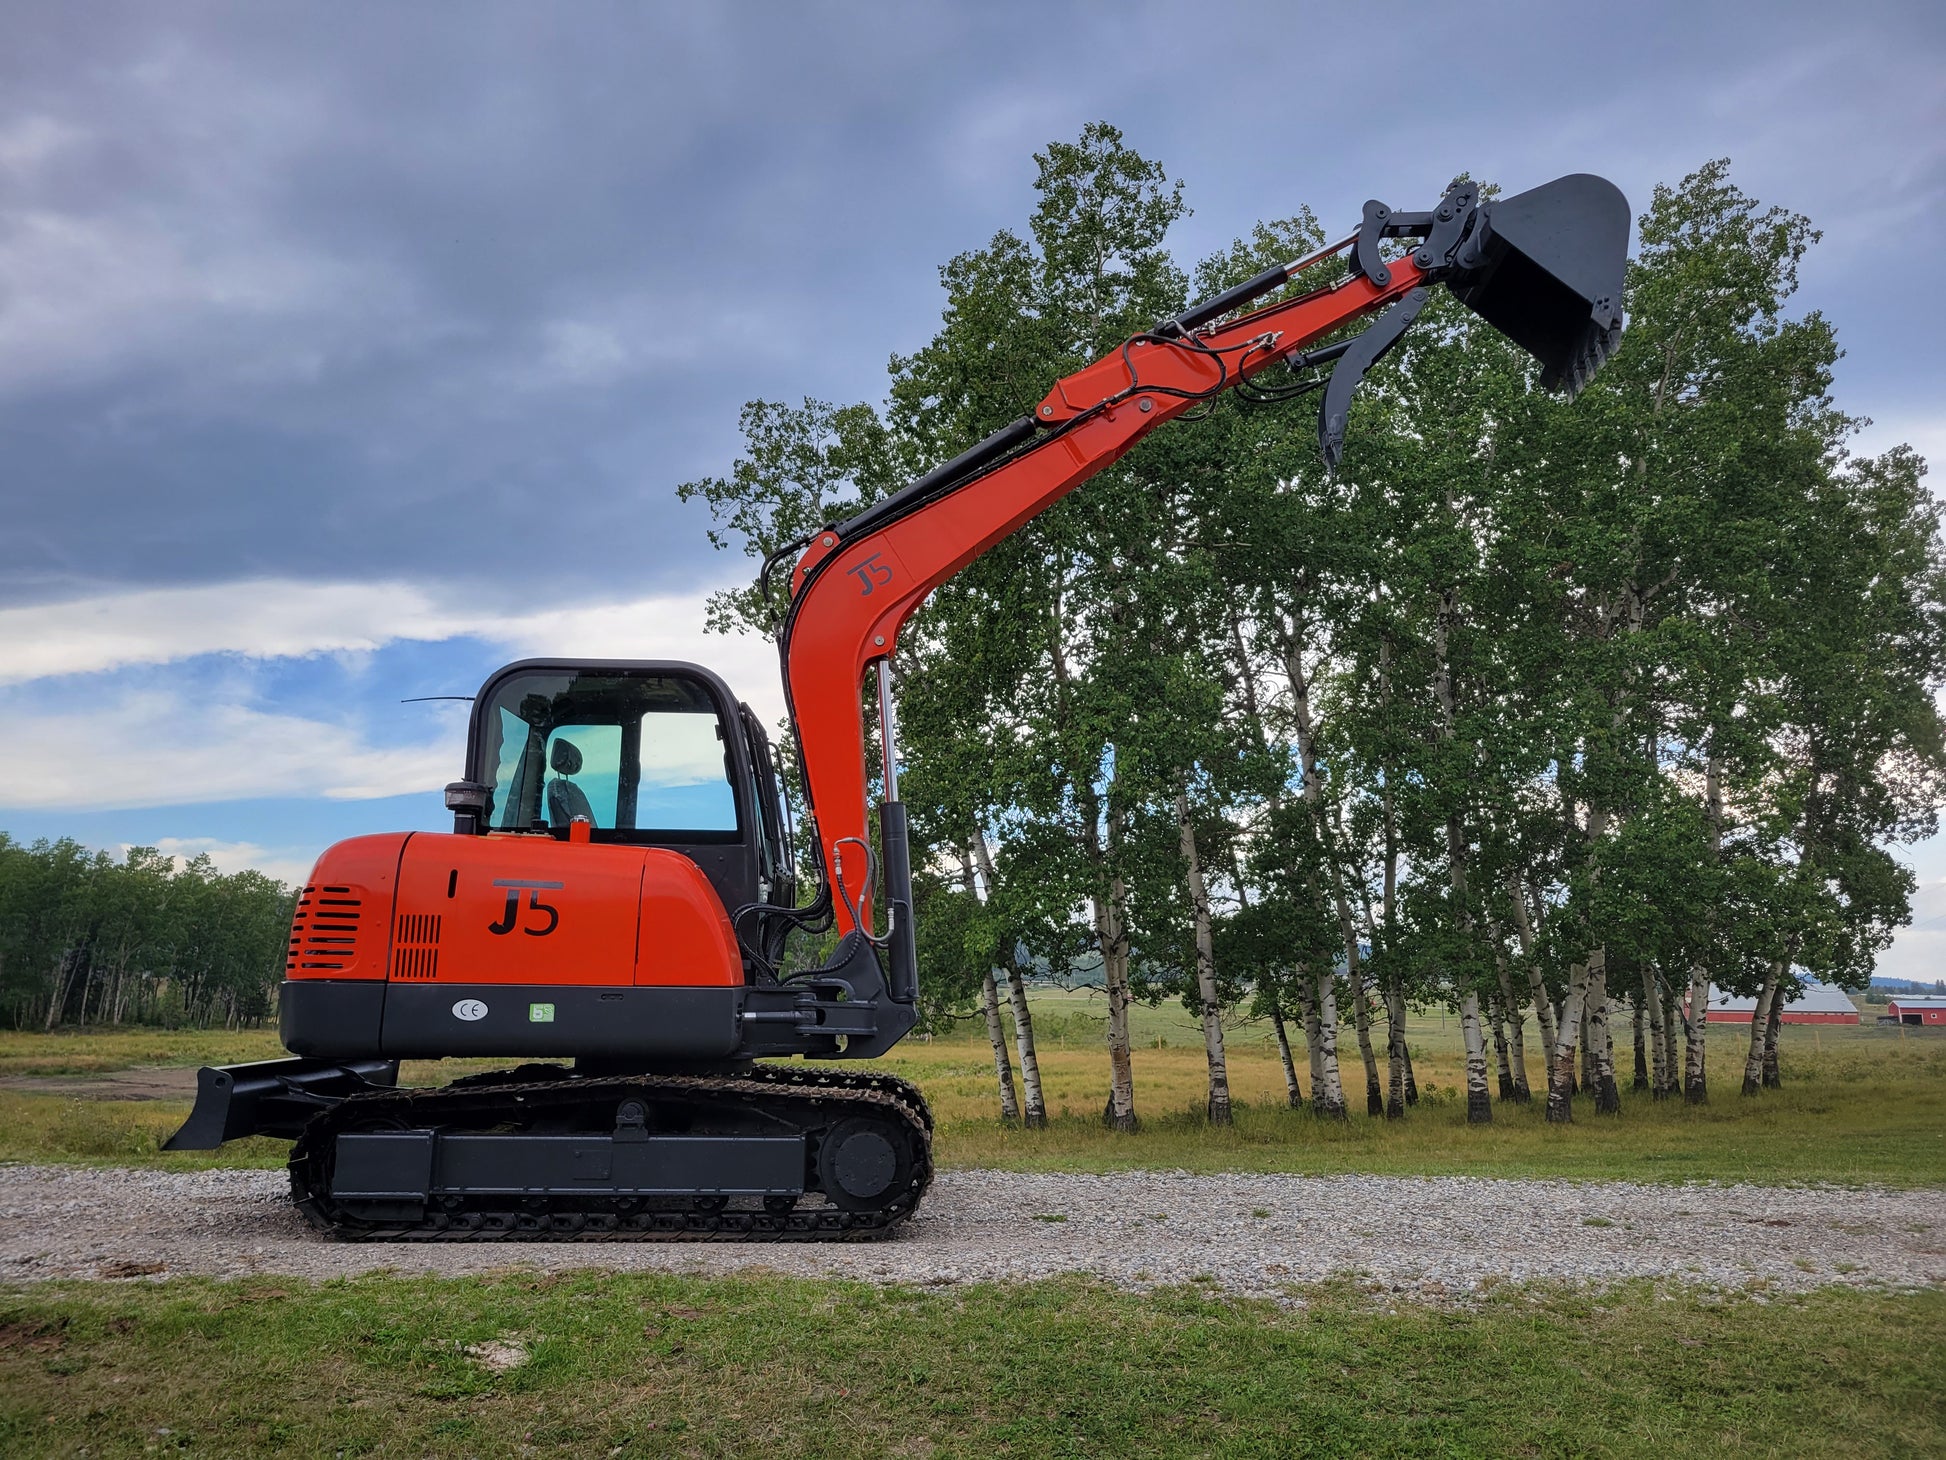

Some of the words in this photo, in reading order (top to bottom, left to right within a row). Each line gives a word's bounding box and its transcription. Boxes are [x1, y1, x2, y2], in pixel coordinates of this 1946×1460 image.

[847, 552, 893, 596] J5
[487, 879, 564, 936] J5
[460, 1003, 479, 1017] CE
